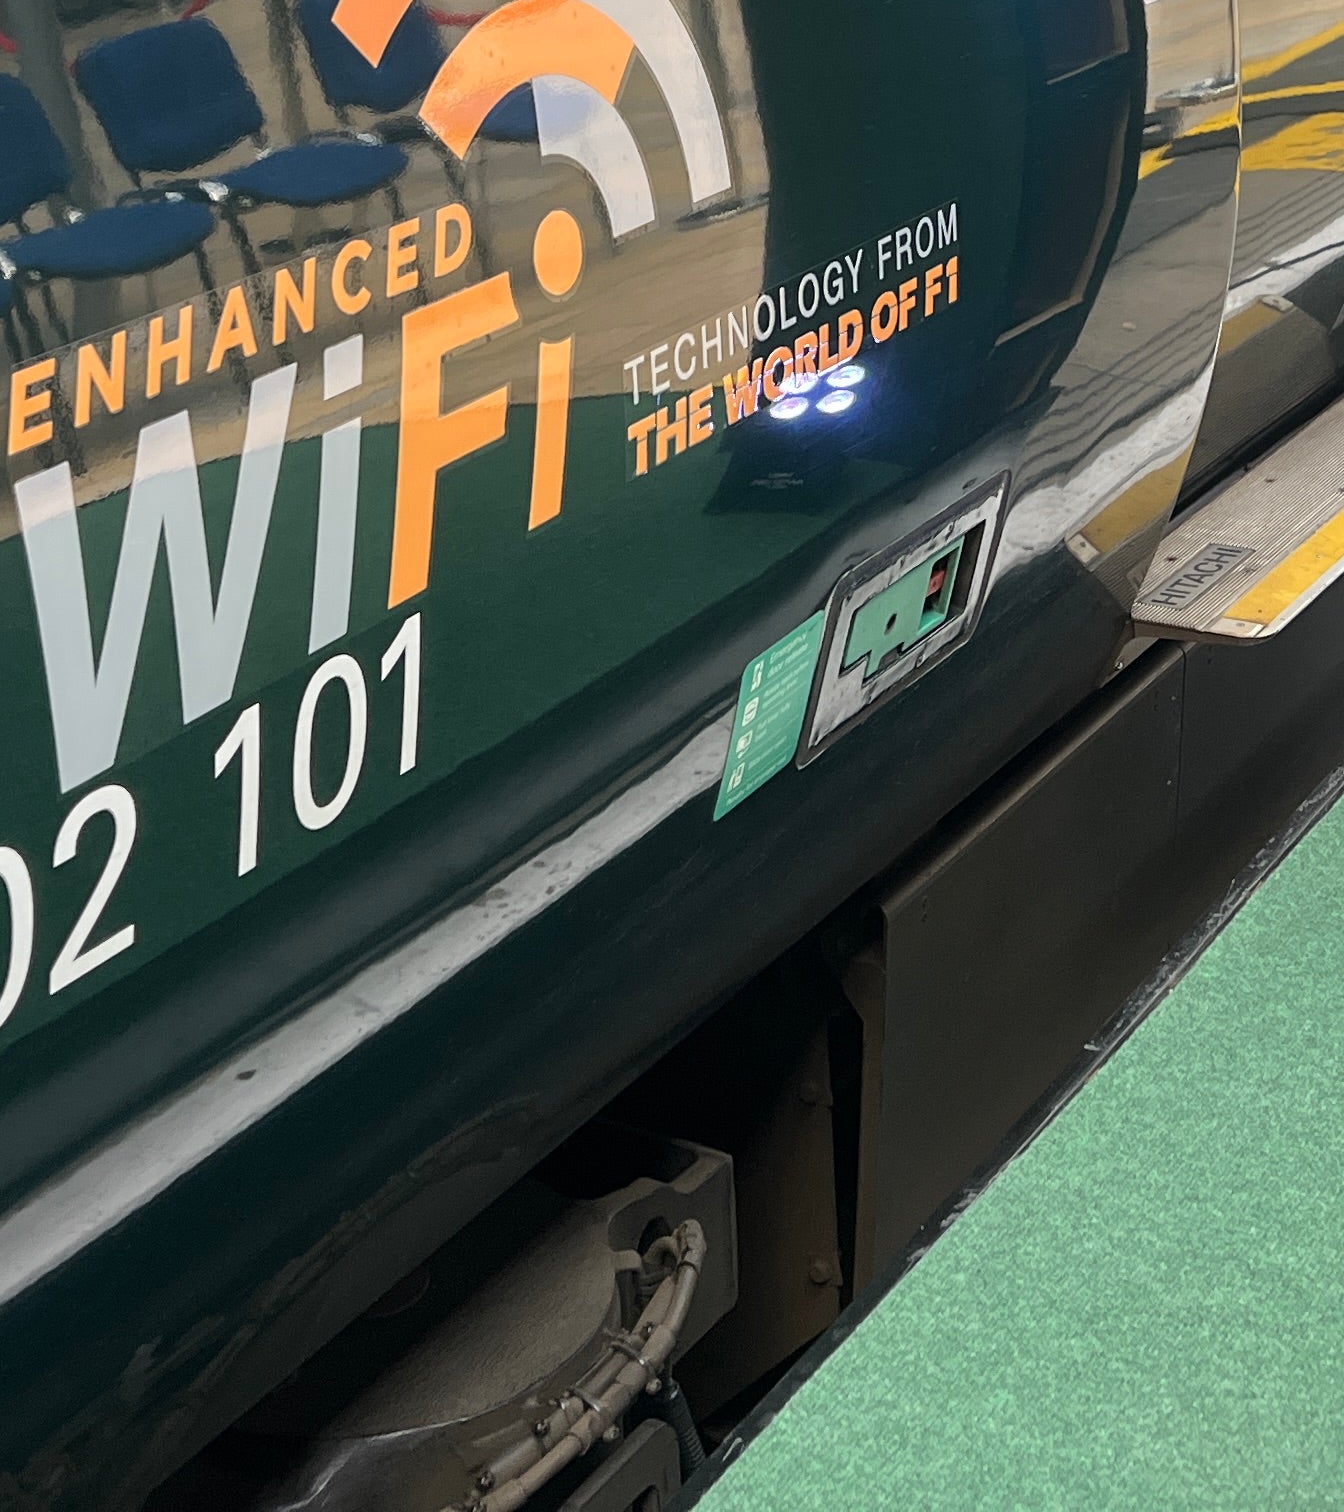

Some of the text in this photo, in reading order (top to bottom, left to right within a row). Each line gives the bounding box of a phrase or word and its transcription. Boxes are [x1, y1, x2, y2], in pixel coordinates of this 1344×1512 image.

[8, 203, 472, 455] ENHANCED
[623, 203, 958, 405] TECHNOLOGY FROM
[627, 256, 958, 477] THE WORLD OF F1
[14, 210, 583, 794] WiFi
[1150, 547, 1243, 606] HITACHI
[214, 612, 421, 878] 101
